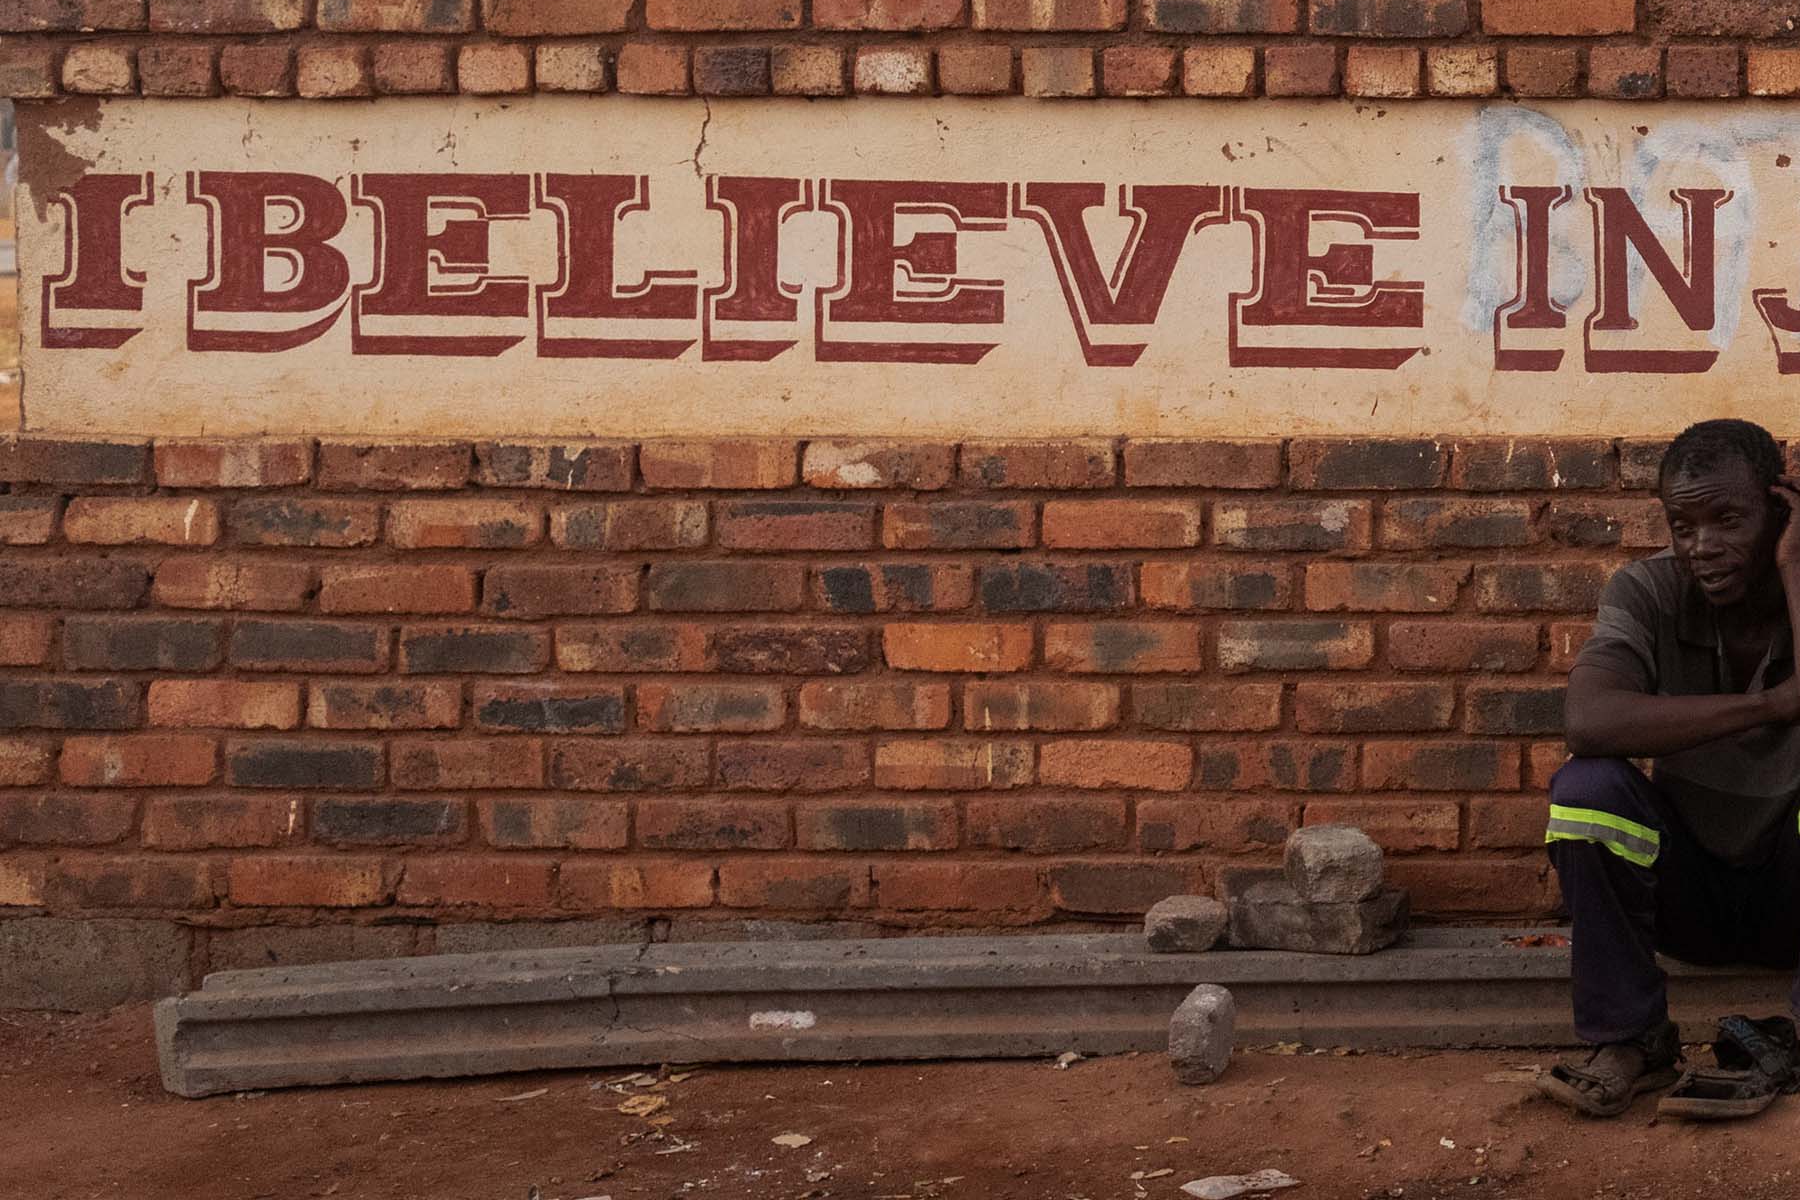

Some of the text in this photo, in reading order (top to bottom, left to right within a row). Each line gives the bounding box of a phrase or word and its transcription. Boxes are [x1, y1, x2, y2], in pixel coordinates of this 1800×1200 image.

[41, 171, 154, 349] I
[186, 171, 1424, 369] BELIEVE
[1494, 185, 1733, 373] IN
